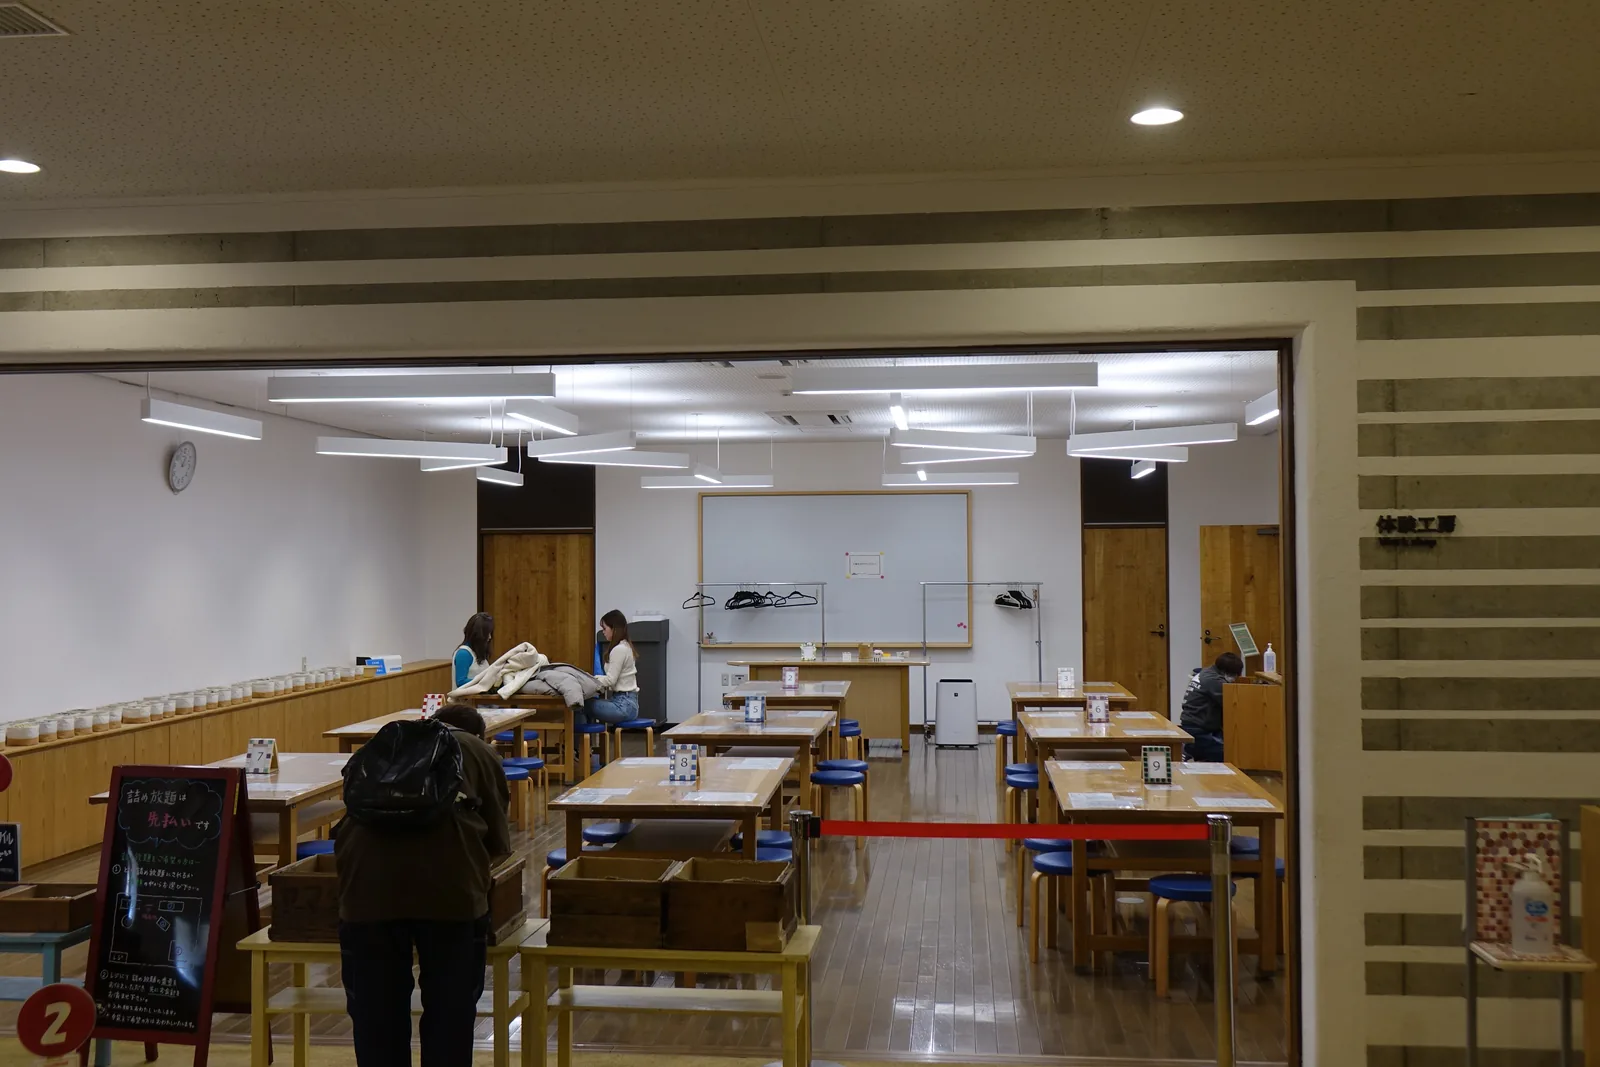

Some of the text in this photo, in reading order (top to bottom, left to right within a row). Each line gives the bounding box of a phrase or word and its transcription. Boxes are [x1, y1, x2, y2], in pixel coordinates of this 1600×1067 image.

[1095, 705, 1101, 713] 6
[257, 752, 264, 761] 7
[680, 758, 688, 767] 8
[1152, 761, 1160, 771] 9
[127, 789, 186, 805] 詰め放題は
[40, 1002, 72, 1045] 2
